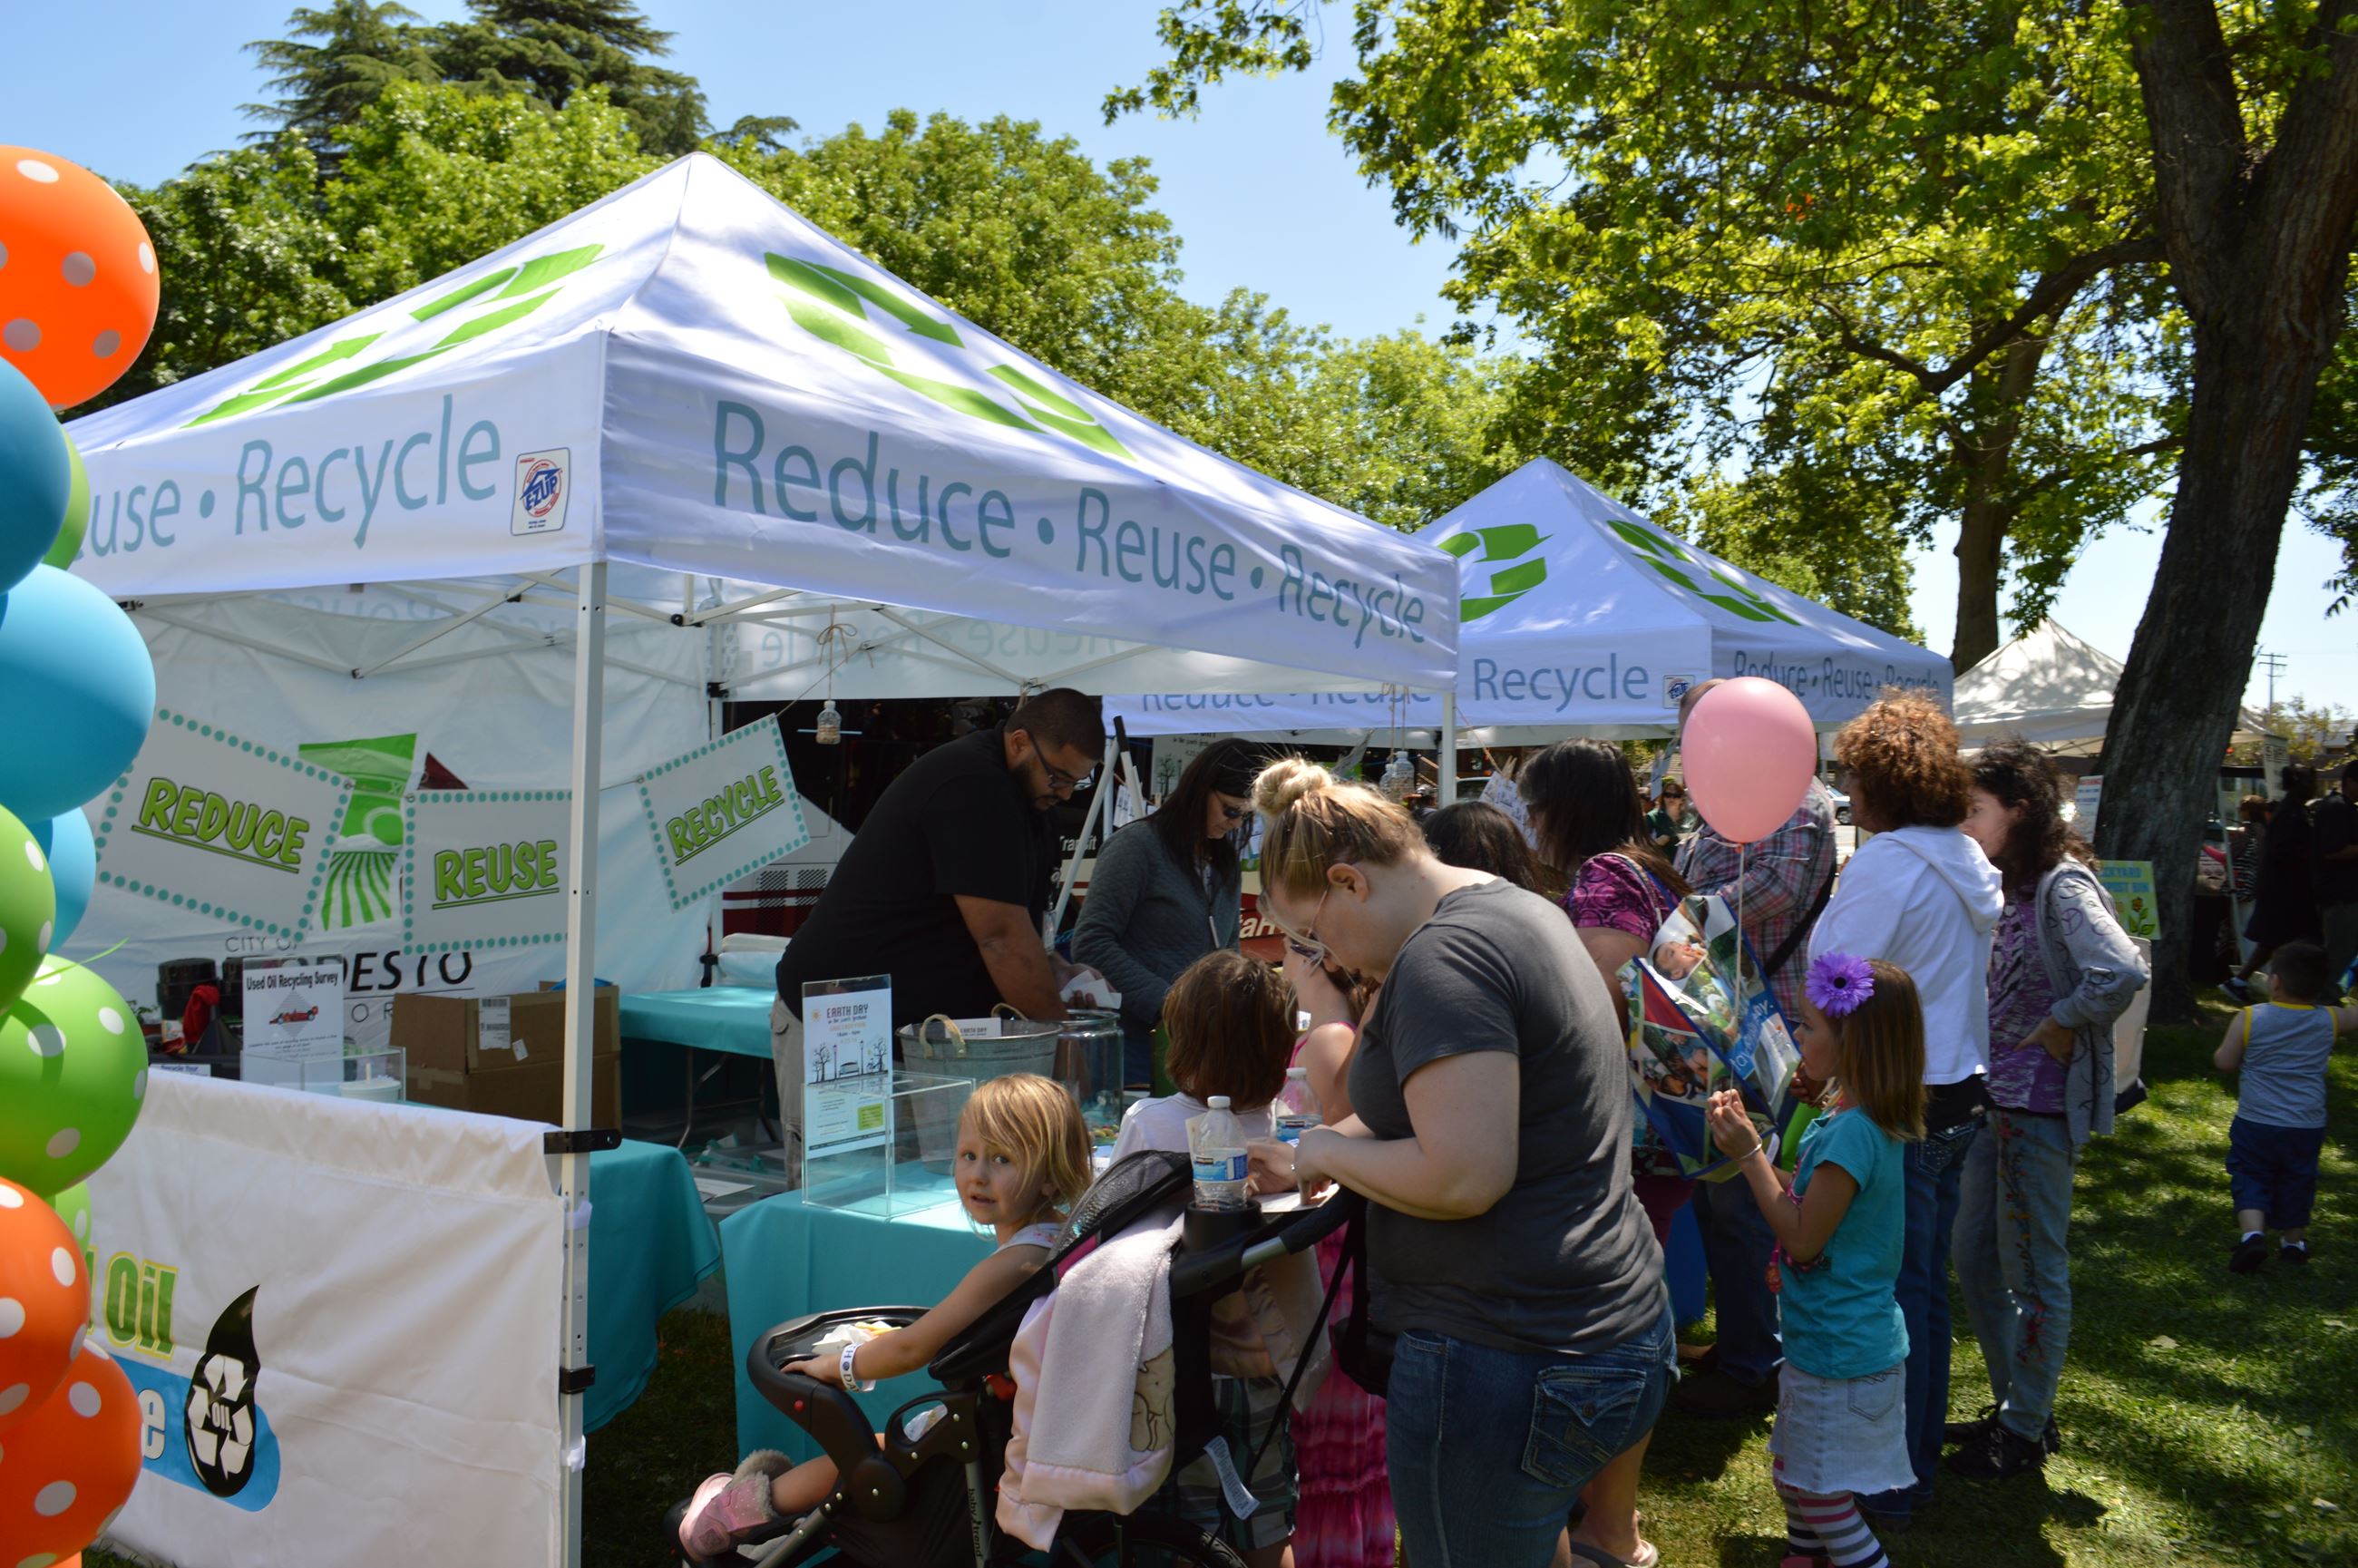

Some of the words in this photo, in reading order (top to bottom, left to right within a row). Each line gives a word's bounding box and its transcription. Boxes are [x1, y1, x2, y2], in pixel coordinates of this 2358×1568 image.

[73, 480, 180, 561] use
[234, 394, 501, 550] Recycle
[714, 400, 1016, 559] Reduce
[1076, 487, 1235, 600] Reuse
[1279, 544, 1425, 648] Recycle
[1474, 652, 1649, 714] Recycle
[1823, 657, 1872, 700] Reuse
[138, 777, 310, 865] REDUCE
[667, 765, 783, 858] RECYCLE
[434, 840, 559, 901] REUSE
[1059, 835, 1097, 852] rait
[225, 936, 267, 952] CITY
[276, 937, 297, 951] O
[246, 976, 266, 990] Used
[267, 974, 277, 989] Oil
[278, 972, 313, 990] Recycling
[315, 971, 339, 987] Survey
[826, 1006, 852, 1018] EARTH
[853, 1003, 869, 1016] DAY
[103, 1251, 180, 1360] Oil
